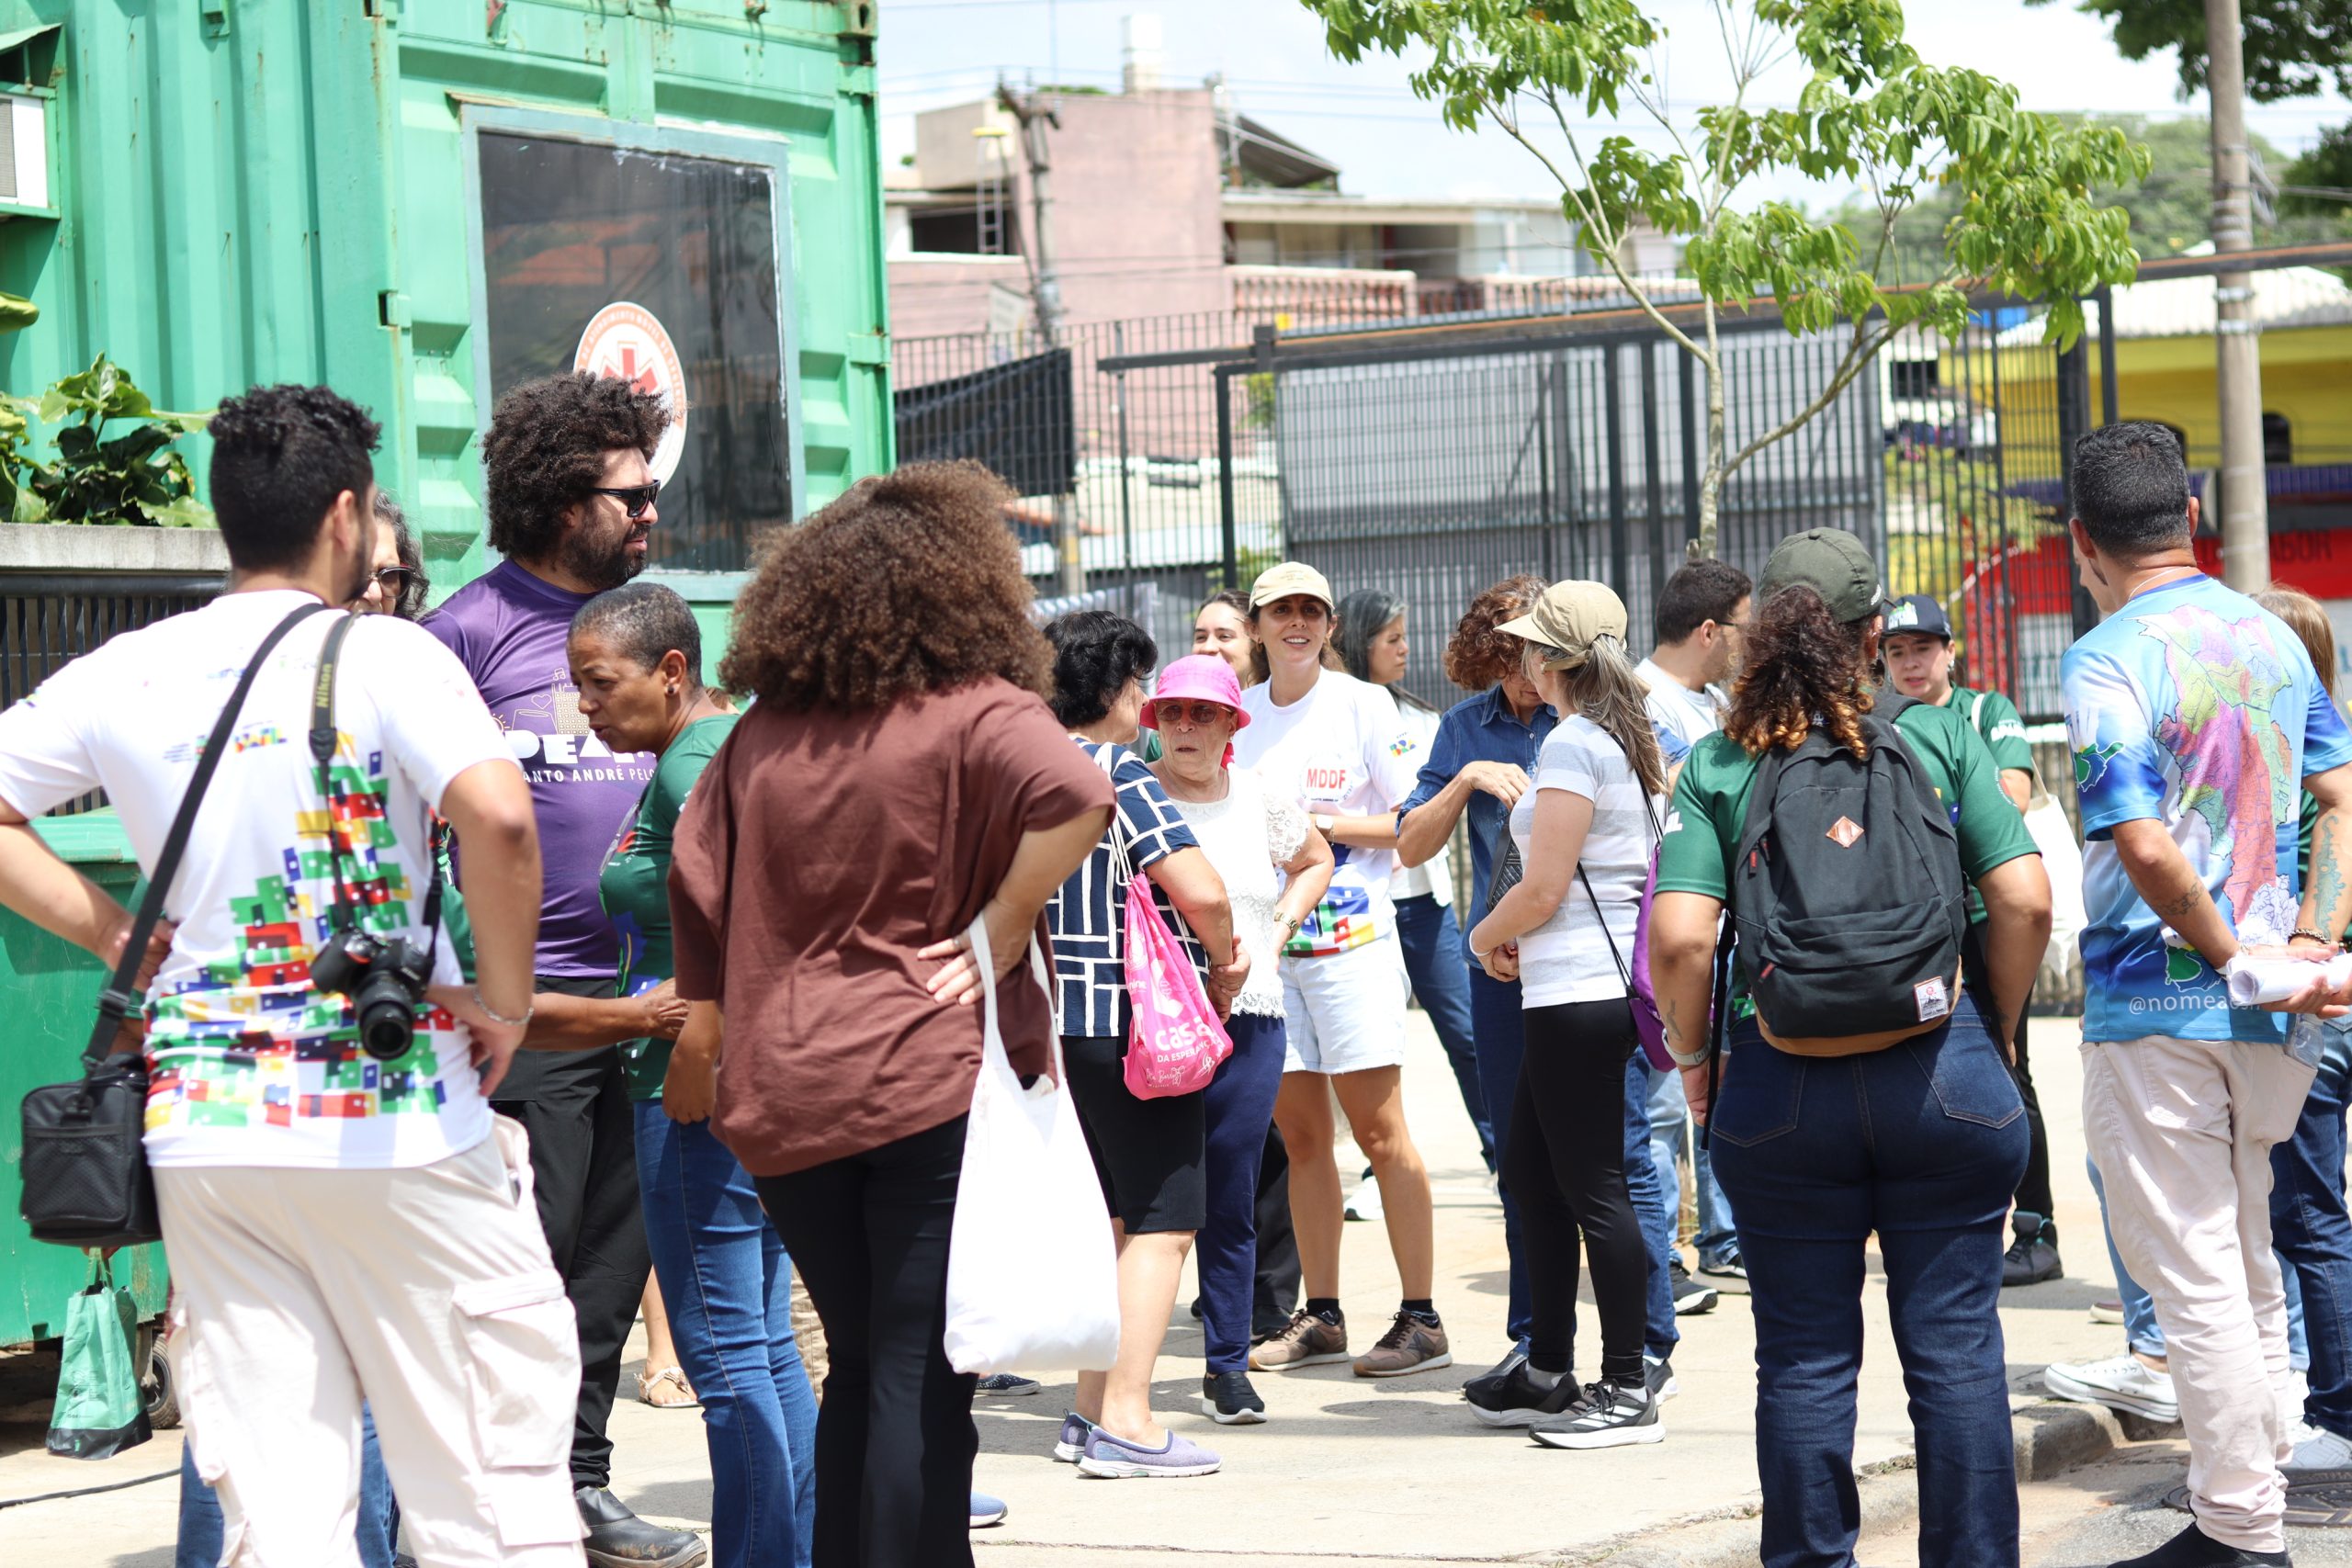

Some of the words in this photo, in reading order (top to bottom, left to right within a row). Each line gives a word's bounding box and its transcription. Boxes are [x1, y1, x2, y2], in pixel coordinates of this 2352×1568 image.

[315, 663, 334, 708] Nikon
[524, 770, 564, 783] ANTO
[573, 765, 625, 783] ANDRÉ
[1306, 768, 1347, 790] MDDF
[1158, 1055, 1170, 1063] DA
[1171, 1040, 1212, 1062] ESPERANÇ
